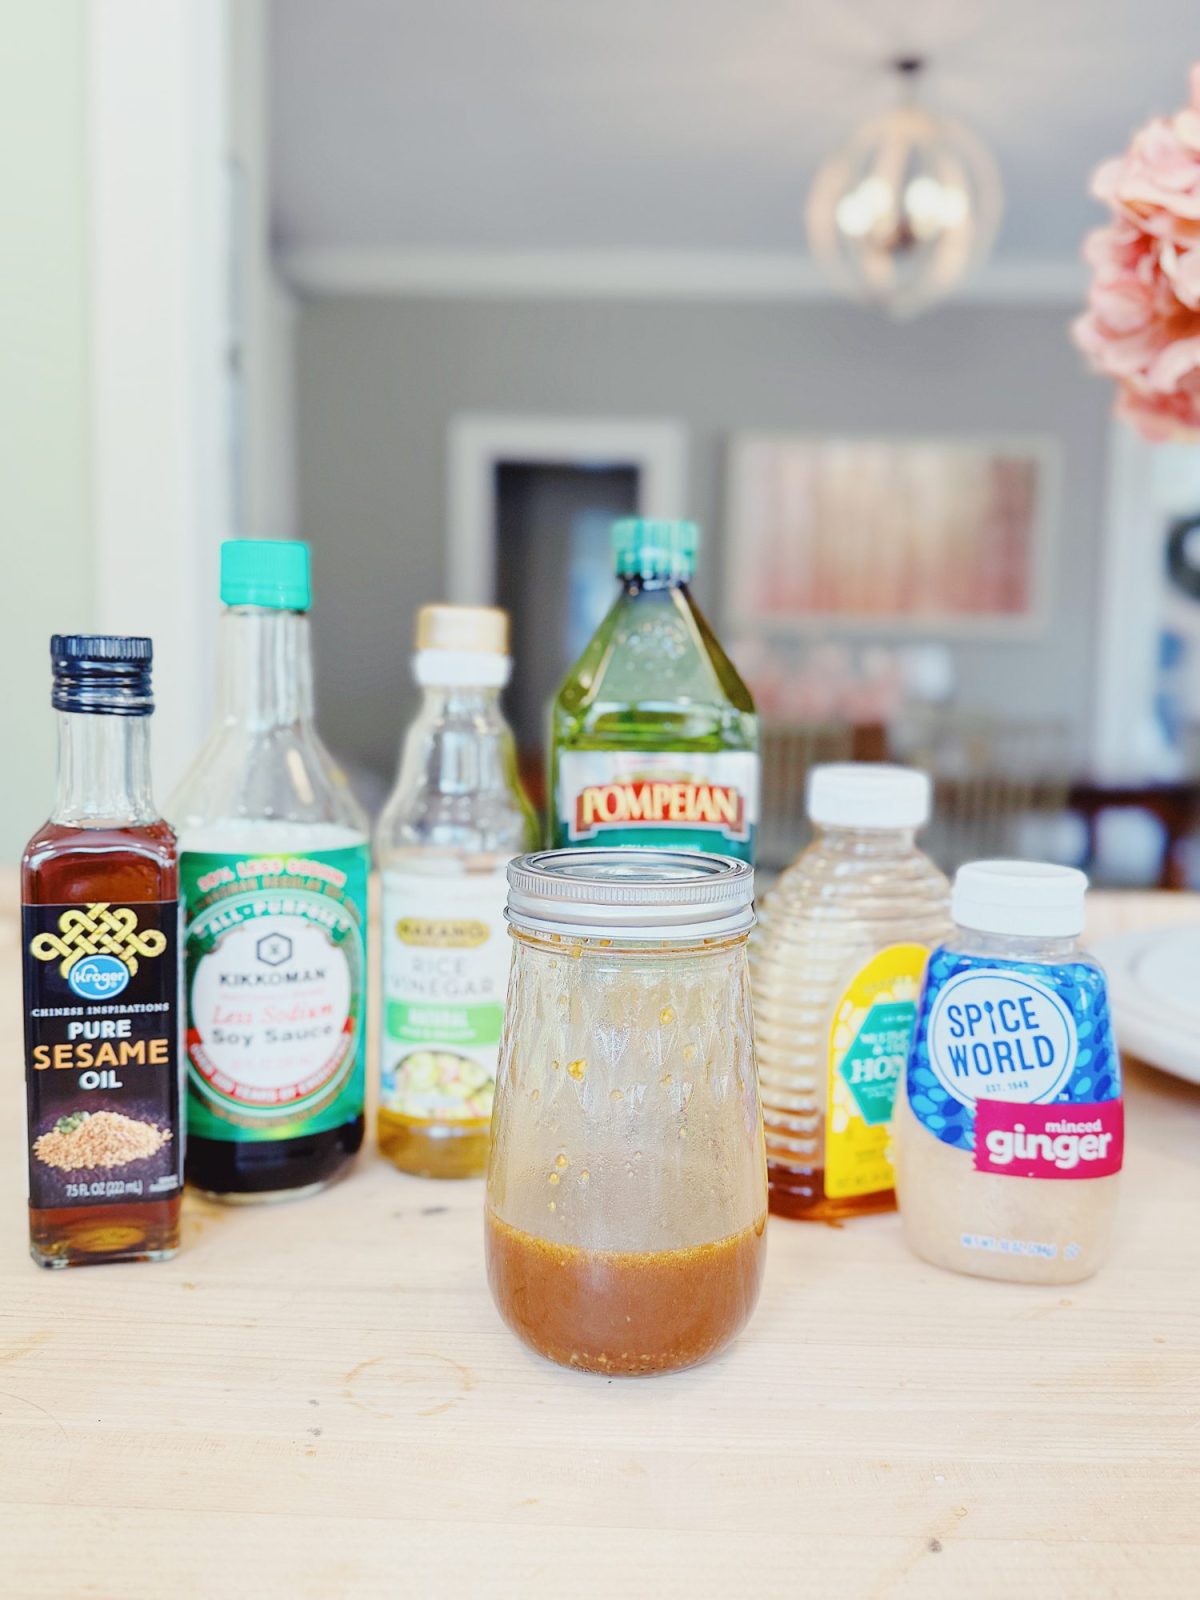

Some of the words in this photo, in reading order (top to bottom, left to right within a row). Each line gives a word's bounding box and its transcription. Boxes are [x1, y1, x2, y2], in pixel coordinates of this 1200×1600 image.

[583, 782, 738, 825] POMPEIAN
[411, 956, 465, 976] RICE
[75, 964, 125, 991] Kroger
[219, 969, 326, 986] KIKKOMAN
[31, 1007, 84, 1018] CHINESE
[87, 1002, 170, 1016] INSPIRATIONS
[212, 1004, 253, 1025] Less
[262, 1003, 333, 1023] Sodium
[947, 996, 1040, 1038] SPICE
[67, 1019, 132, 1040] PURE
[212, 1029, 254, 1047] Soy
[265, 1025, 333, 1044] Sauce
[32, 1039, 169, 1071] SESAME
[947, 1035, 1055, 1078] WORLD
[78, 1070, 123, 1090] OIL
[1045, 1118, 1103, 1134] minced
[985, 1123, 1112, 1170] ginger
